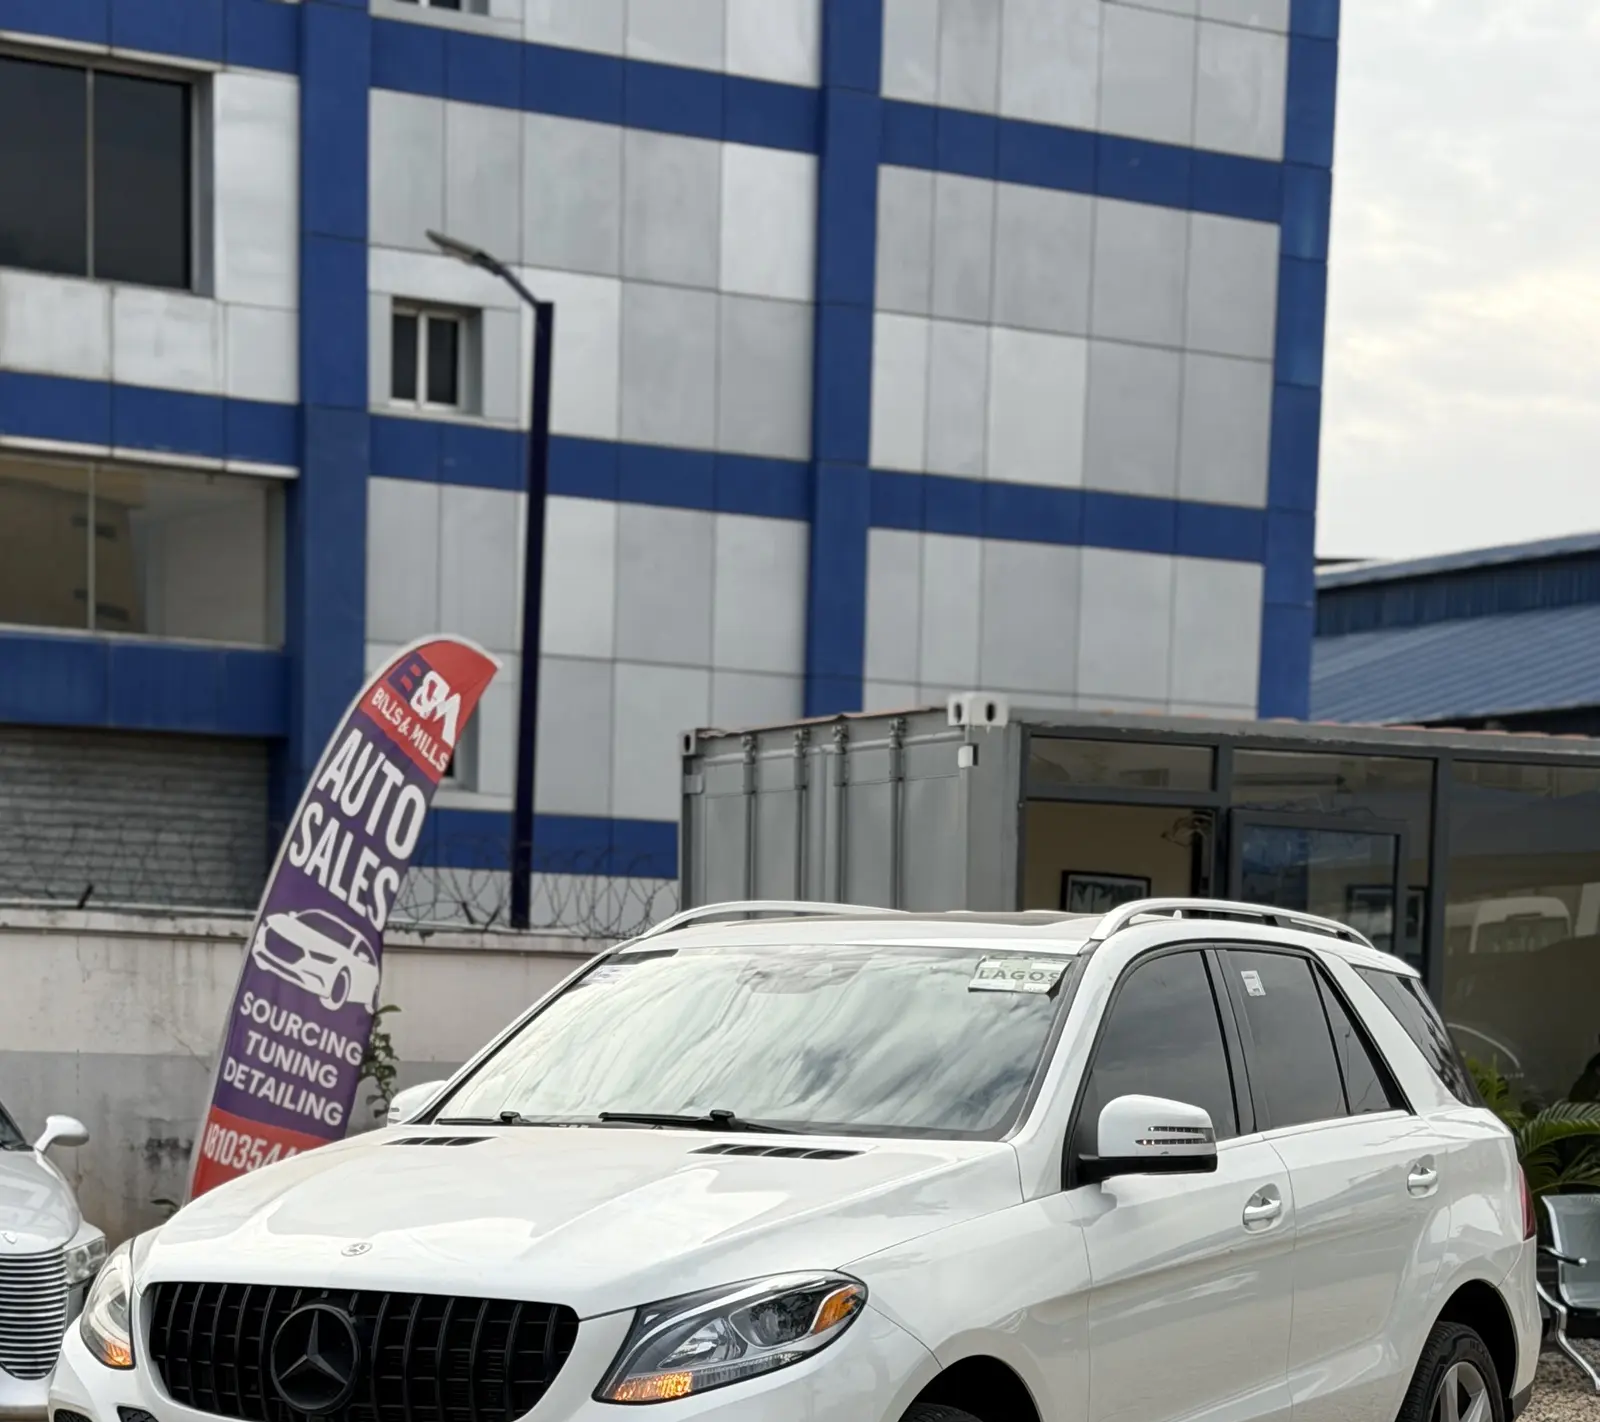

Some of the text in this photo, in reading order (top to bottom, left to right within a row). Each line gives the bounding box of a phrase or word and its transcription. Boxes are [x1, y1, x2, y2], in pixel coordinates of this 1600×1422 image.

[371, 687, 449, 772] BILLS & MILLS
[317, 728, 426, 860] AUTO
[289, 802, 399, 932] SALES
[978, 969, 1060, 983] LAGOS
[240, 991, 363, 1066] SOURCING
[246, 1030, 338, 1088] TUNING
[223, 1057, 344, 1126] DETAILING
